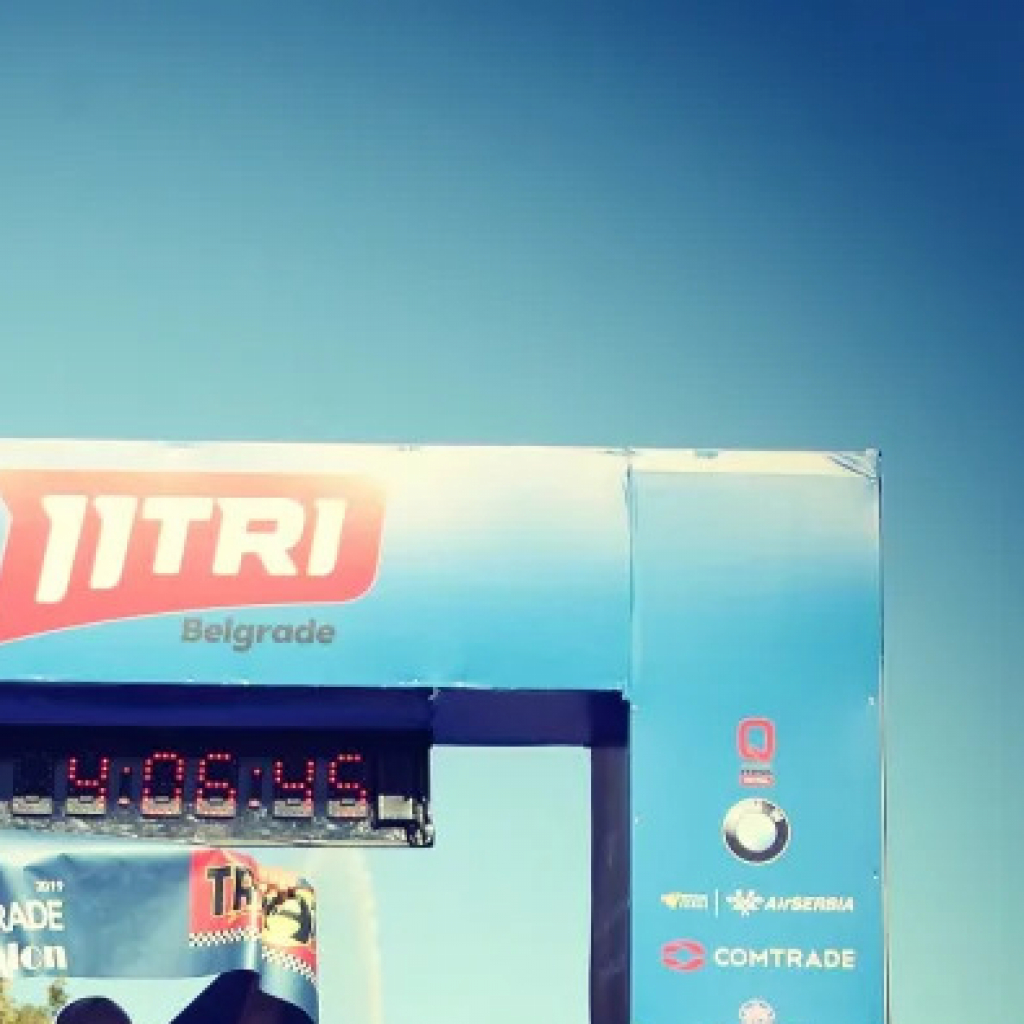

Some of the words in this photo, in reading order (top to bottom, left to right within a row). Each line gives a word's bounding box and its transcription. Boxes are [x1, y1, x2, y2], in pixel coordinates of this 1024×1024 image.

[181, 617, 336, 652] Belgrade
[736, 716, 777, 762] Q
[713, 947, 857, 969] COMTRADE
